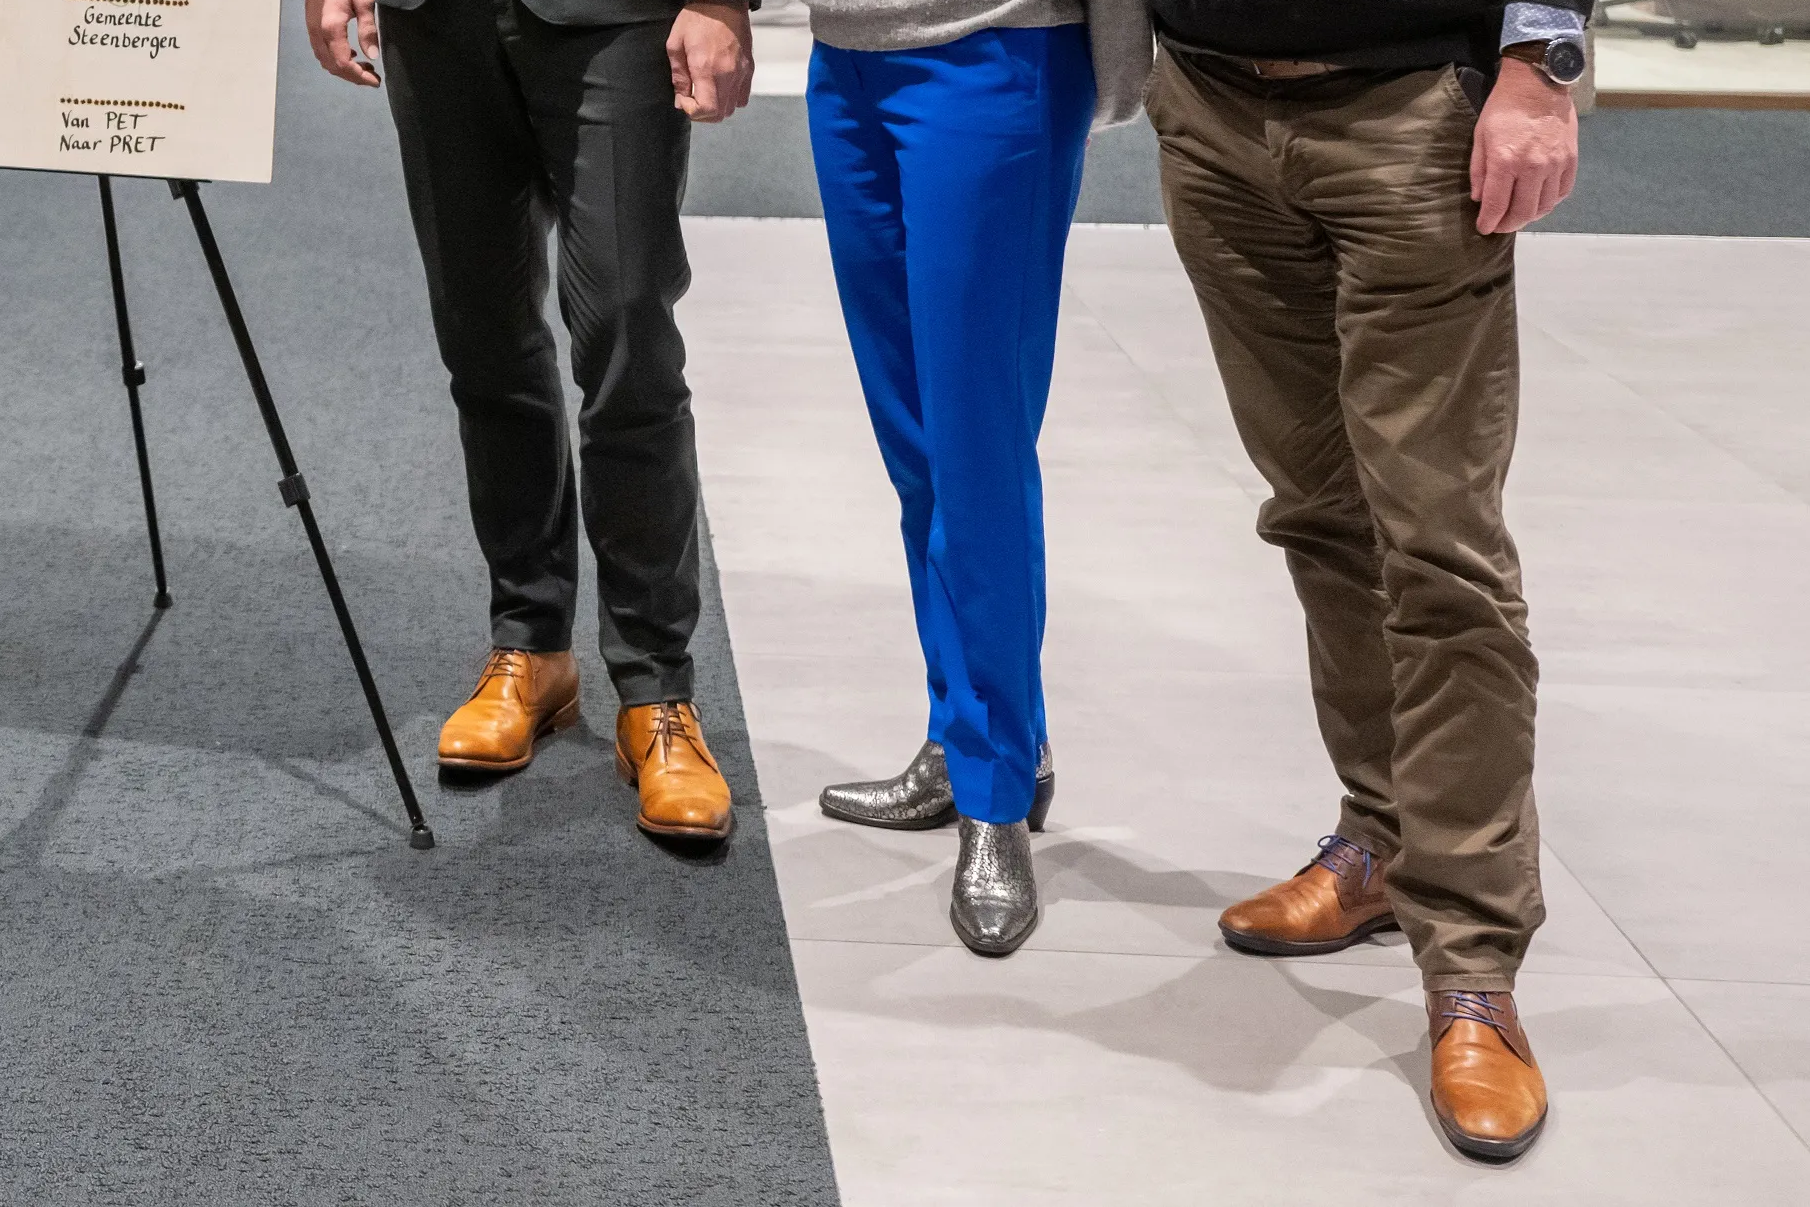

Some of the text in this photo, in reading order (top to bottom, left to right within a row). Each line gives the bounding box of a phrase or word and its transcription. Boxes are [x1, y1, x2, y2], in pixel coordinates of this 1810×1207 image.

[84, 6, 162, 27] Gemeente
[68, 25, 180, 59] Steenbergen
[61, 110, 147, 130] Van PET
[59, 134, 165, 154] Naar PRET
